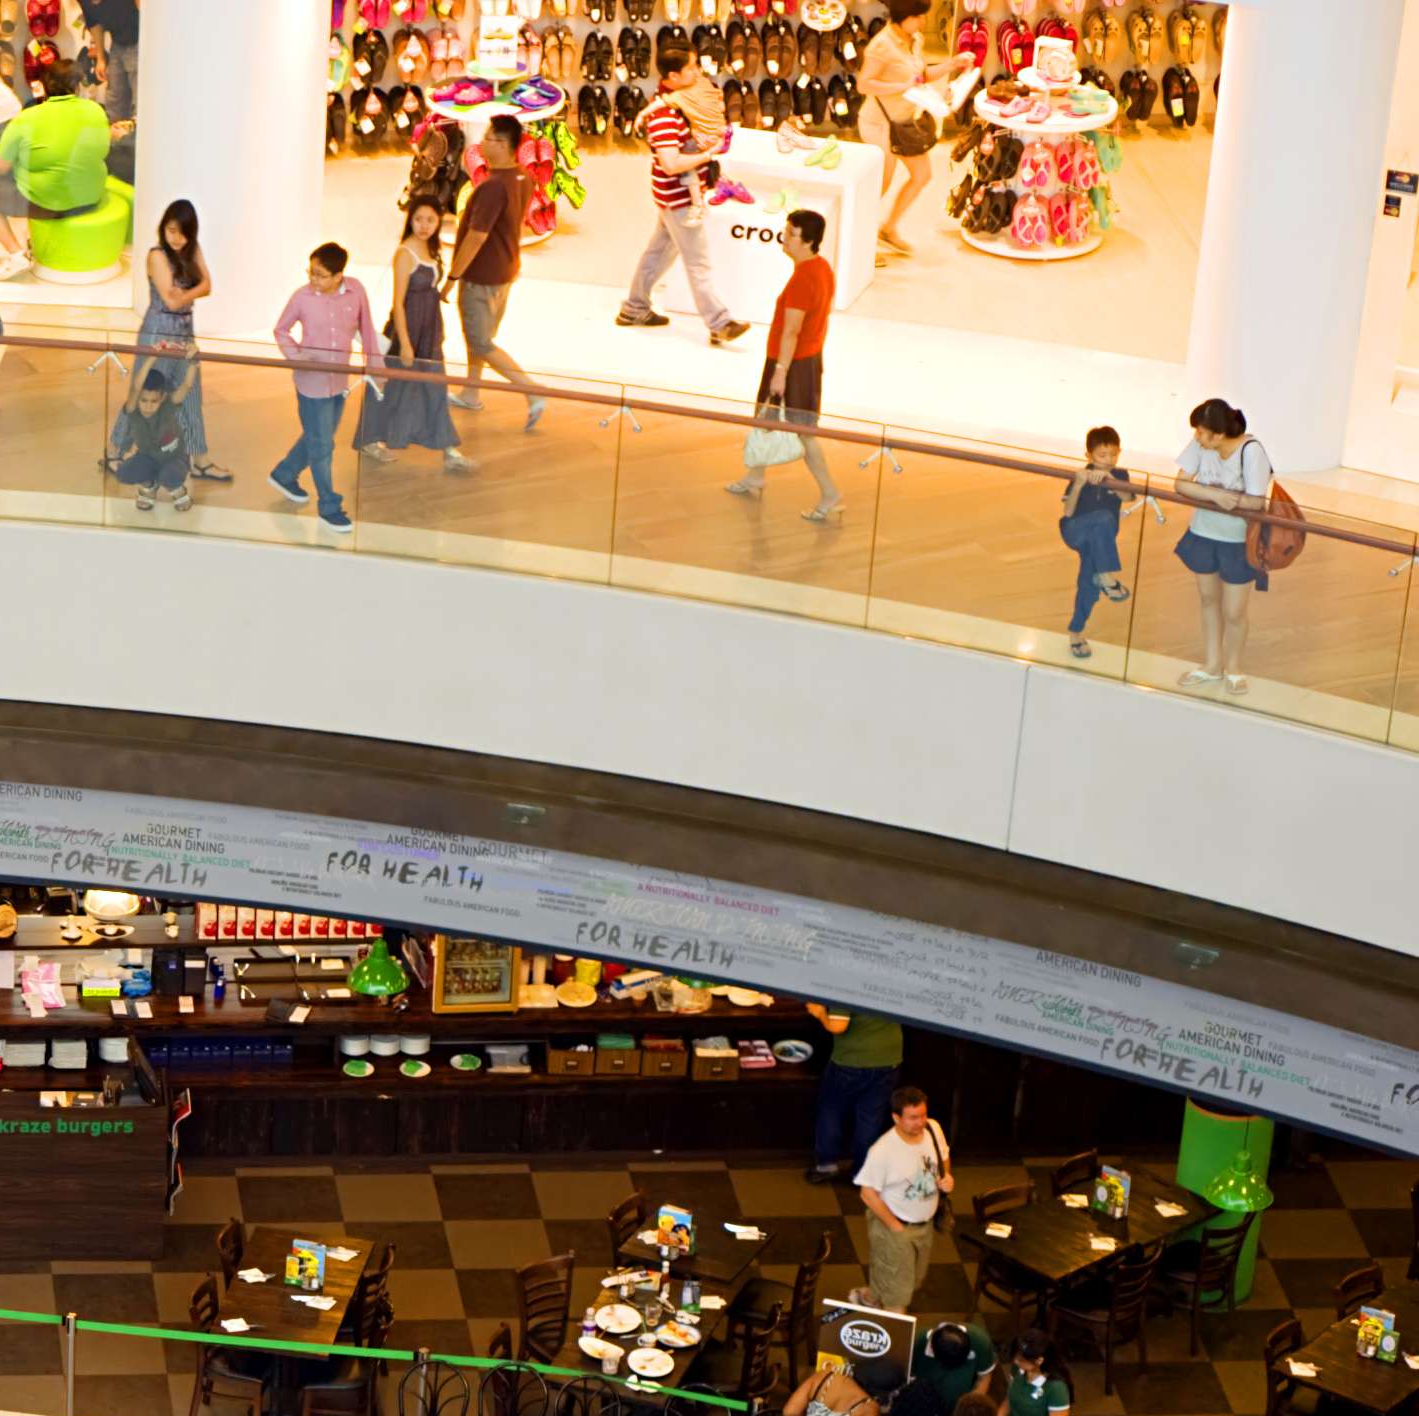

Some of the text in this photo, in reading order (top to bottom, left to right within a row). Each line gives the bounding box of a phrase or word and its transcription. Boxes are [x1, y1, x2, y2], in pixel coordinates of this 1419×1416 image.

[731, 224, 784, 245] croc
[43, 787, 83, 802] DINING
[146, 823, 203, 838] GOURMET
[122, 833, 225, 855] AMERICAN DINING
[386, 833, 447, 853] AMERICAN
[28, 854, 49, 863] FOOD
[51, 850, 96, 875] FOR
[231, 859, 252, 870] DIET
[326, 849, 371, 876] FOR
[382, 861, 484, 892] HEALTH
[423, 895, 522, 918] FABULOUS AMERICAN FOOD
[644, 884, 711, 904] NUTRITIONALLY
[714, 896, 760, 913] BALANCED
[761, 905, 781, 918] DIET
[576, 921, 734, 969] FOR HEALTH
[1036, 950, 1143, 989] AMERICAN DINING
[995, 1013, 1100, 1048] FABULOUS AMERICAN FOOD
[1205, 1021, 1263, 1047] GOURMET
[1101, 1036, 1147, 1068] FOR
[1178, 1028, 1285, 1068] AMERICAN DINING
[1390, 1083, 1419, 1106] FO
[56, 1118, 135, 1137] burgers
